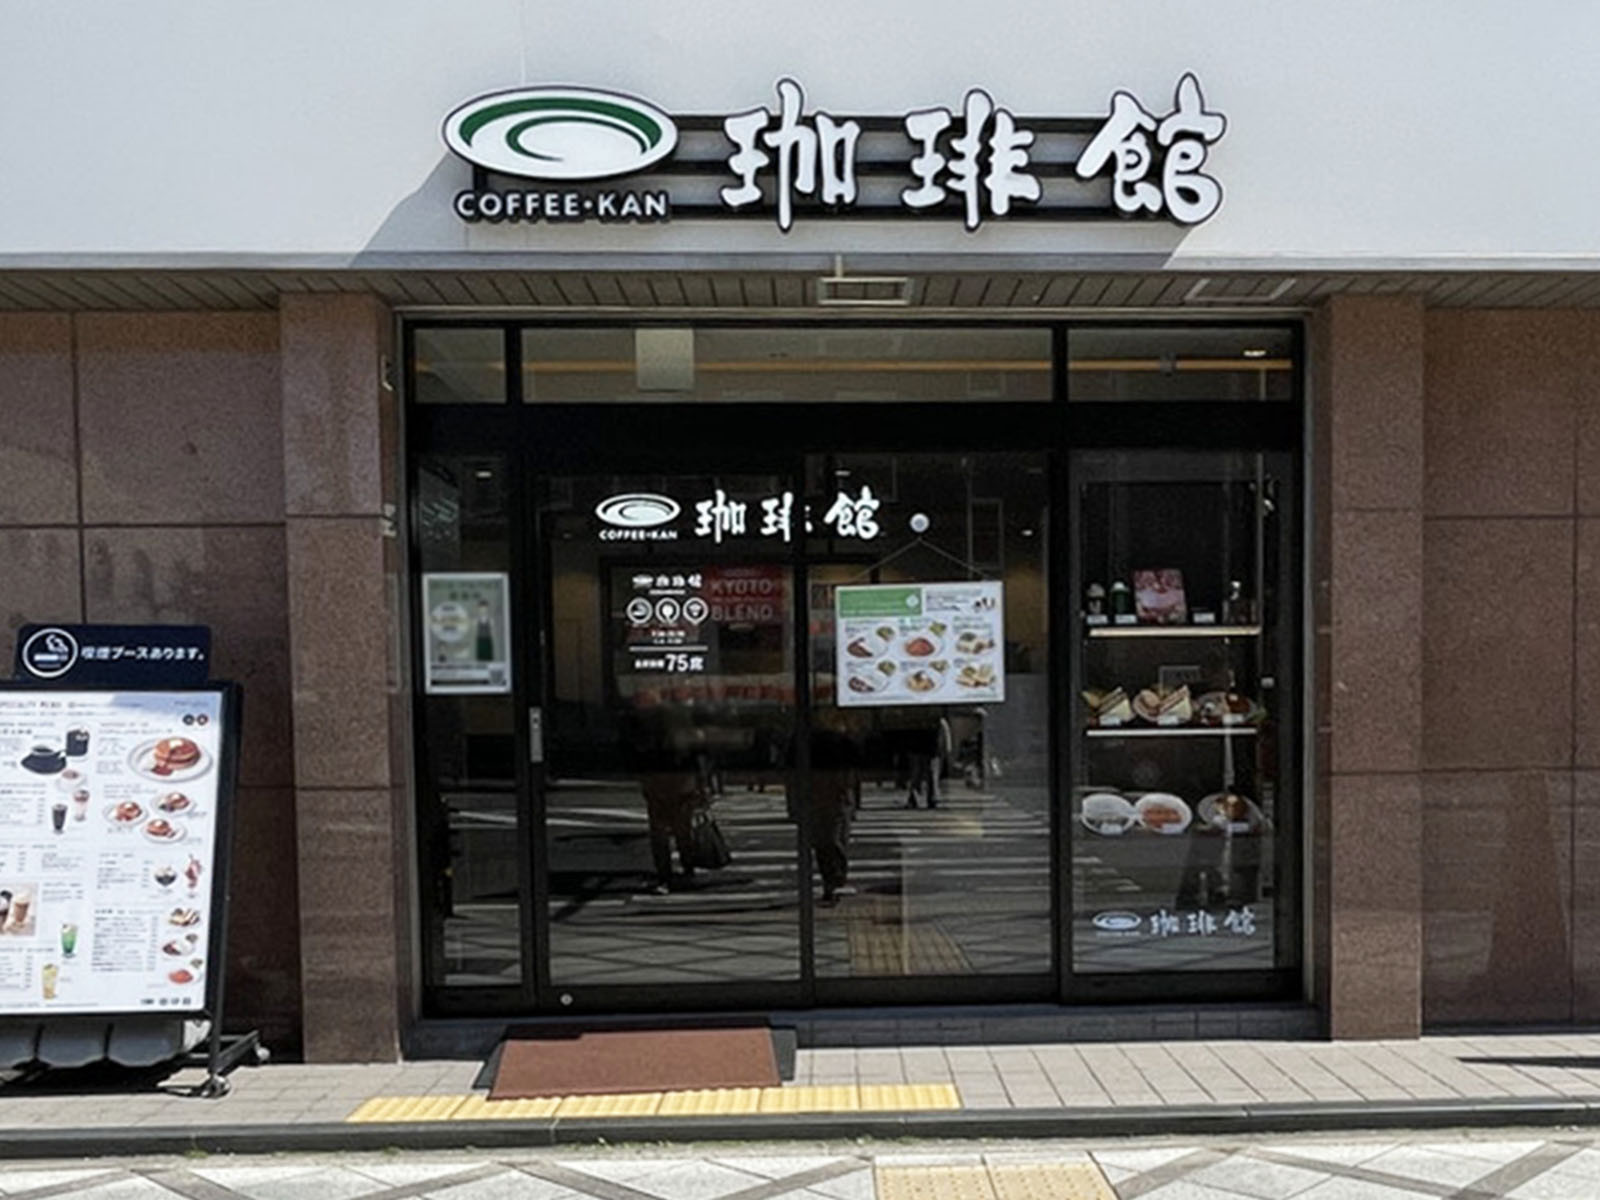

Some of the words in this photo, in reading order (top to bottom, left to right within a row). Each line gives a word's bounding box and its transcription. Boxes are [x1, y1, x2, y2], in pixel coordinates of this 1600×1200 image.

[721, 73, 1227, 229] 珈琲館
[710, 577, 774, 595] KYOTO
[710, 603, 775, 622] BLEND
